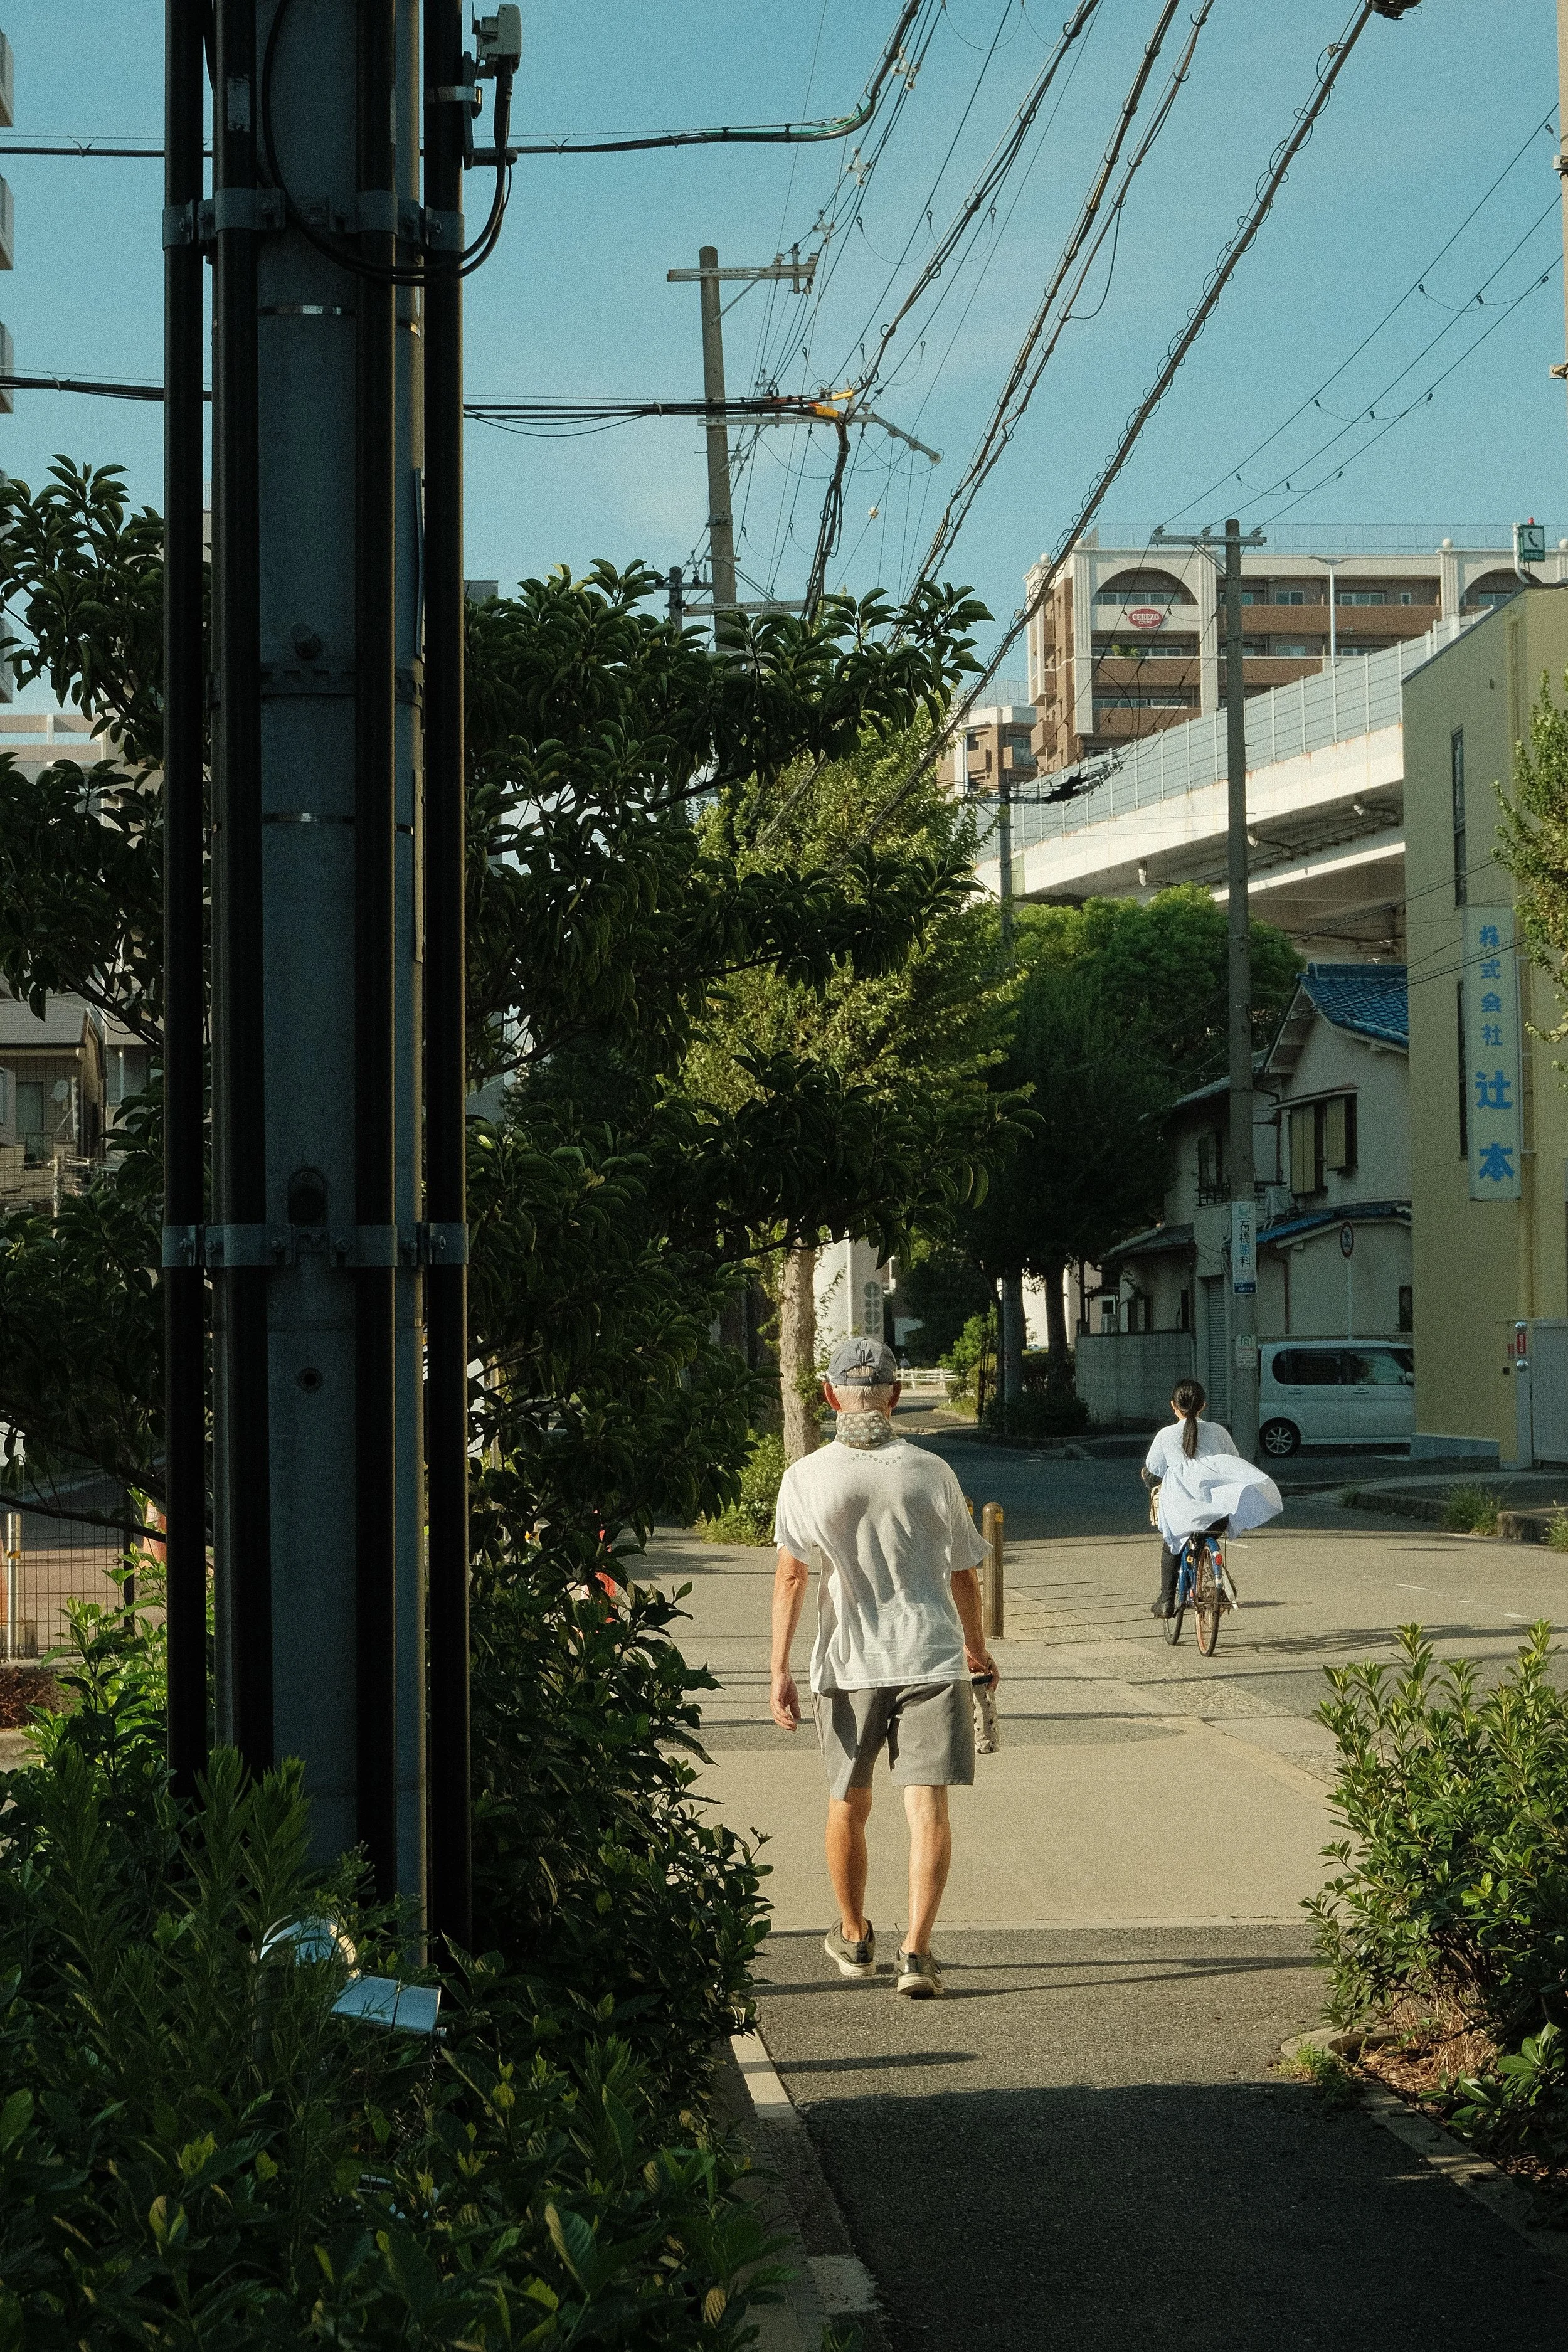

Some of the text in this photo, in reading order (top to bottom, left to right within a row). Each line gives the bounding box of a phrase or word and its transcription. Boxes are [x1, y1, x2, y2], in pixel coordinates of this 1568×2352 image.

[1475, 924, 1515, 1182] 株式会社辻本
[1239, 1221, 1251, 1267] 石橋眼科
